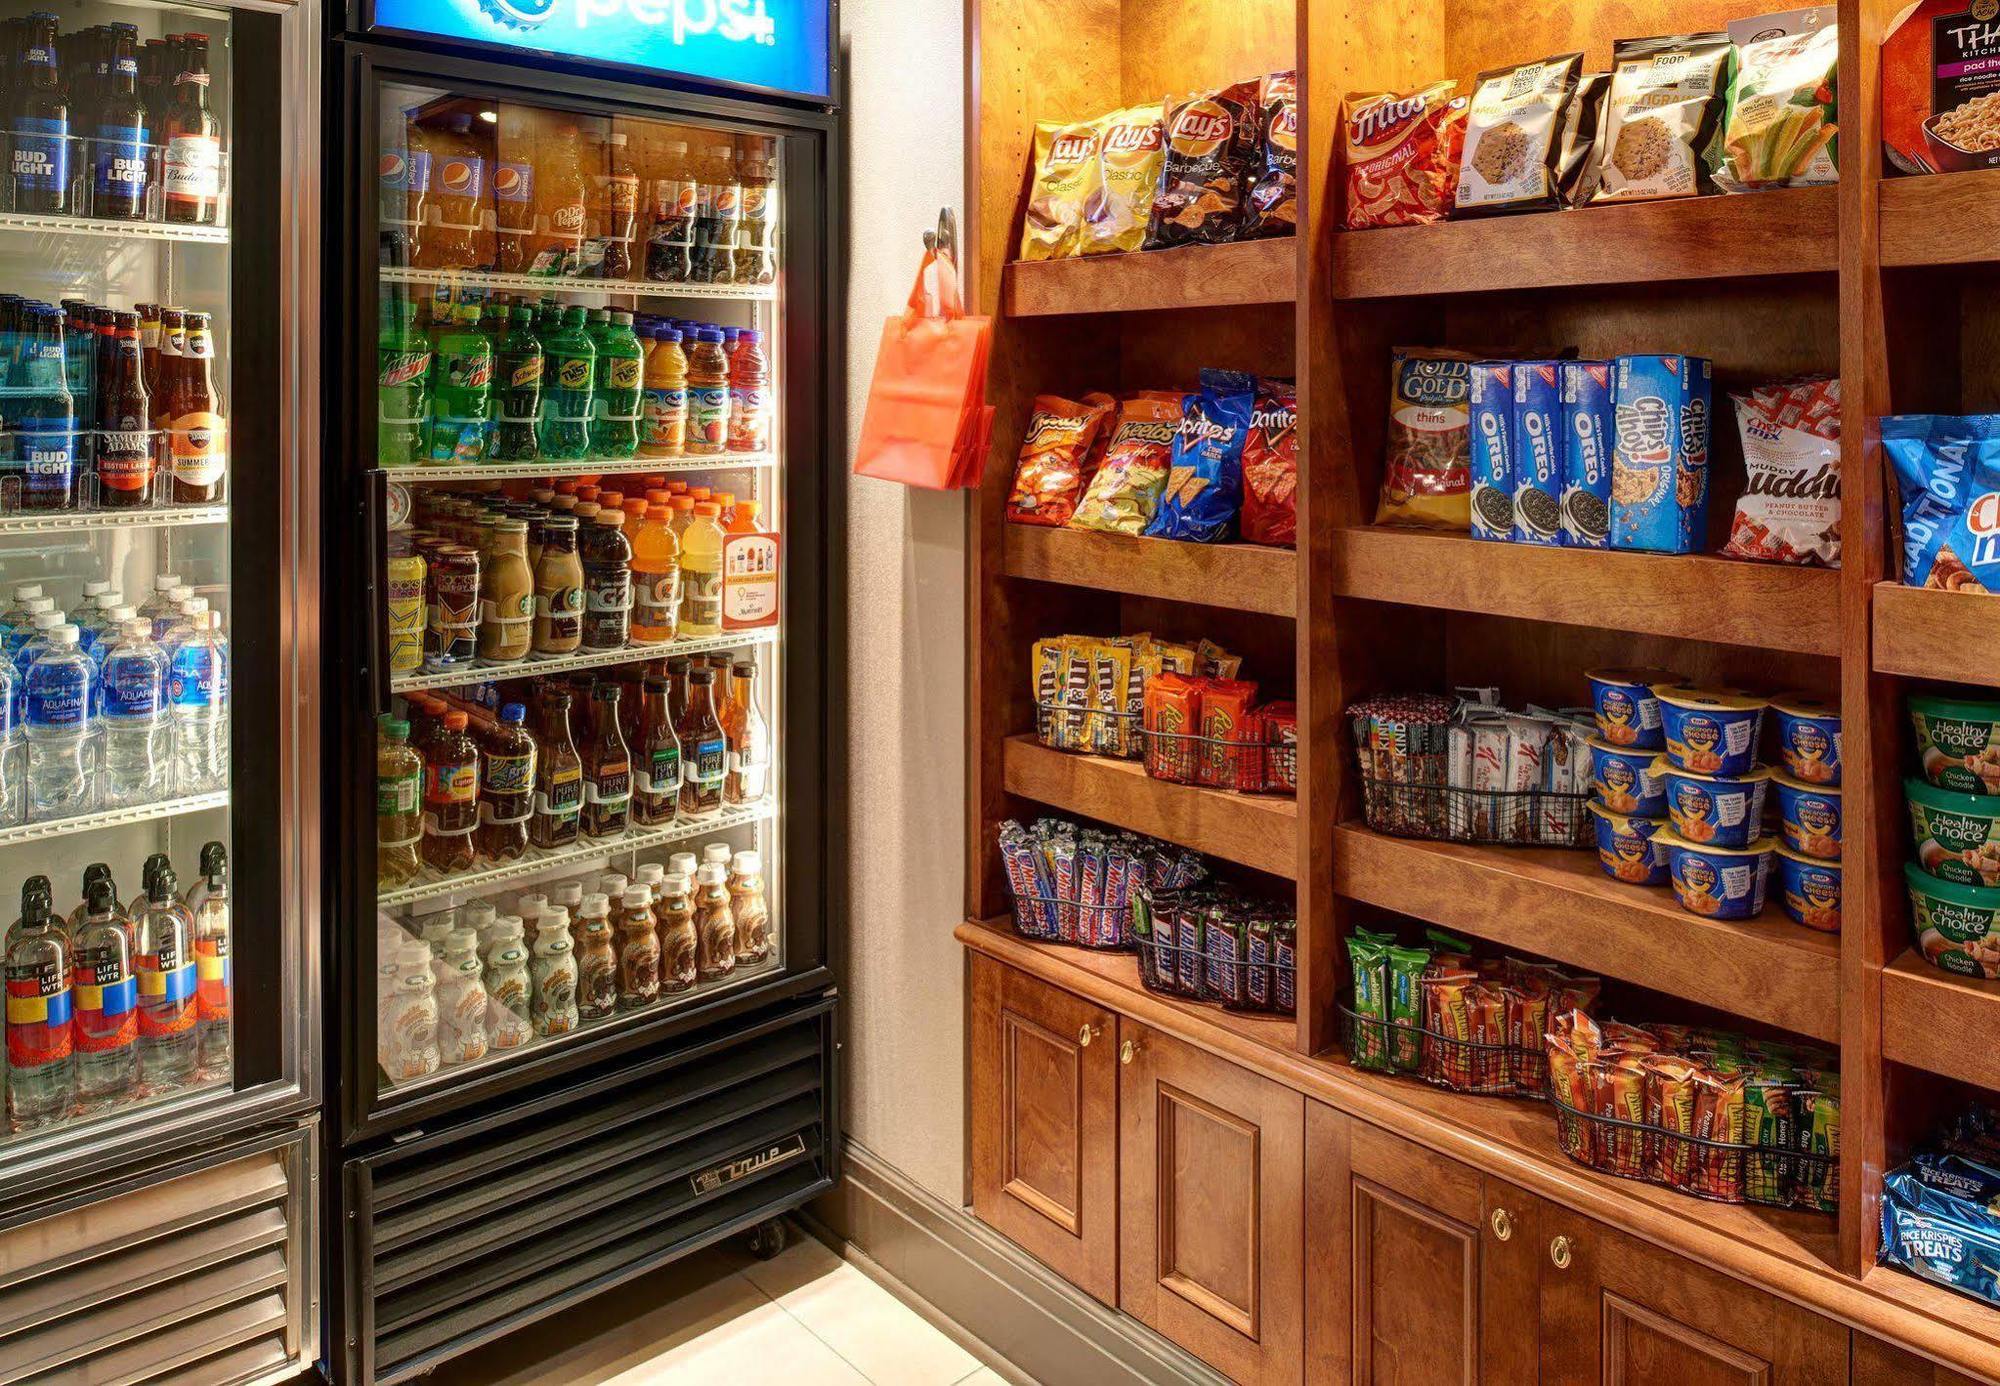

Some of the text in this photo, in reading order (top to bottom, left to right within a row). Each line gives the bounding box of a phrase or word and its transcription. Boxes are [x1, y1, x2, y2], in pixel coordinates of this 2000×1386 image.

[120, 59, 137, 67] BUD
[1656, 56, 1684, 66] FOOD
[1963, 61, 1985, 73] pad
[116, 65, 138, 73] LIGHT
[1516, 66, 1541, 78] FOOD
[1973, 73, 1997, 81] noodle
[1172, 110, 1228, 140] Lay's
[14, 151, 47, 163] BUD
[1369, 144, 1416, 172] ORIGINAL
[11, 162, 54, 175] LIGHT
[114, 158, 145, 170] BUD
[1165, 160, 1221, 173] Barbecue
[107, 169, 147, 183] LIGHT
[408, 157, 416, 185] pepsi
[1414, 362, 1468, 378] ROLD
[1404, 377, 1468, 399] GOLD
[1416, 412, 1445, 423] thins
[1635, 397, 1668, 451] Chips
[1481, 412, 1503, 481] OREO
[1525, 412, 1549, 483] OREO
[1574, 412, 1598, 485] OREO
[32, 451, 68, 463] BUD
[25, 462, 72, 475] LIGHT
[1750, 462, 1796, 475] MUDDY
[1776, 509, 1825, 518] CHOCOLATE
[1799, 504, 1829, 512] BUTTER
[43, 697, 85, 709] AQUAFINA
[1936, 720, 1988, 738] Healthy
[1212, 707, 1233, 769] Reese's
[1396, 723, 1407, 757] KIND
[1931, 730, 1984, 748] Choice
[700, 754, 722, 765] PURE
[655, 762, 679, 774] PURE
[603, 775, 628, 787] PURE
[1946, 771, 1975, 782] Chicken
[556, 784, 579, 796] PURE
[1935, 814, 1988, 832] Healthy
[1930, 822, 1984, 843] Choice
[1942, 863, 1973, 876] Chicken
[1937, 903, 1989, 924] Healthy
[1931, 911, 1985, 934] Choice
[1944, 953, 1974, 966] Chicken
[97, 963, 119, 974] LIFE
[41, 972, 63, 984] LIFE
[97, 972, 120, 982] WTR
[41, 982, 64, 993] WTR
[1702, 1110, 1713, 1138] Peanut
[1778, 1119, 1788, 1145] Honey
[1801, 1130, 1811, 1148] Oats
[1921, 1166, 1941, 1179] RICE
[1922, 1175, 1982, 1192] TREATS
[1901, 1230, 1963, 1248] RICE KRISPIES
[1901, 1241, 1962, 1263] TREATS
